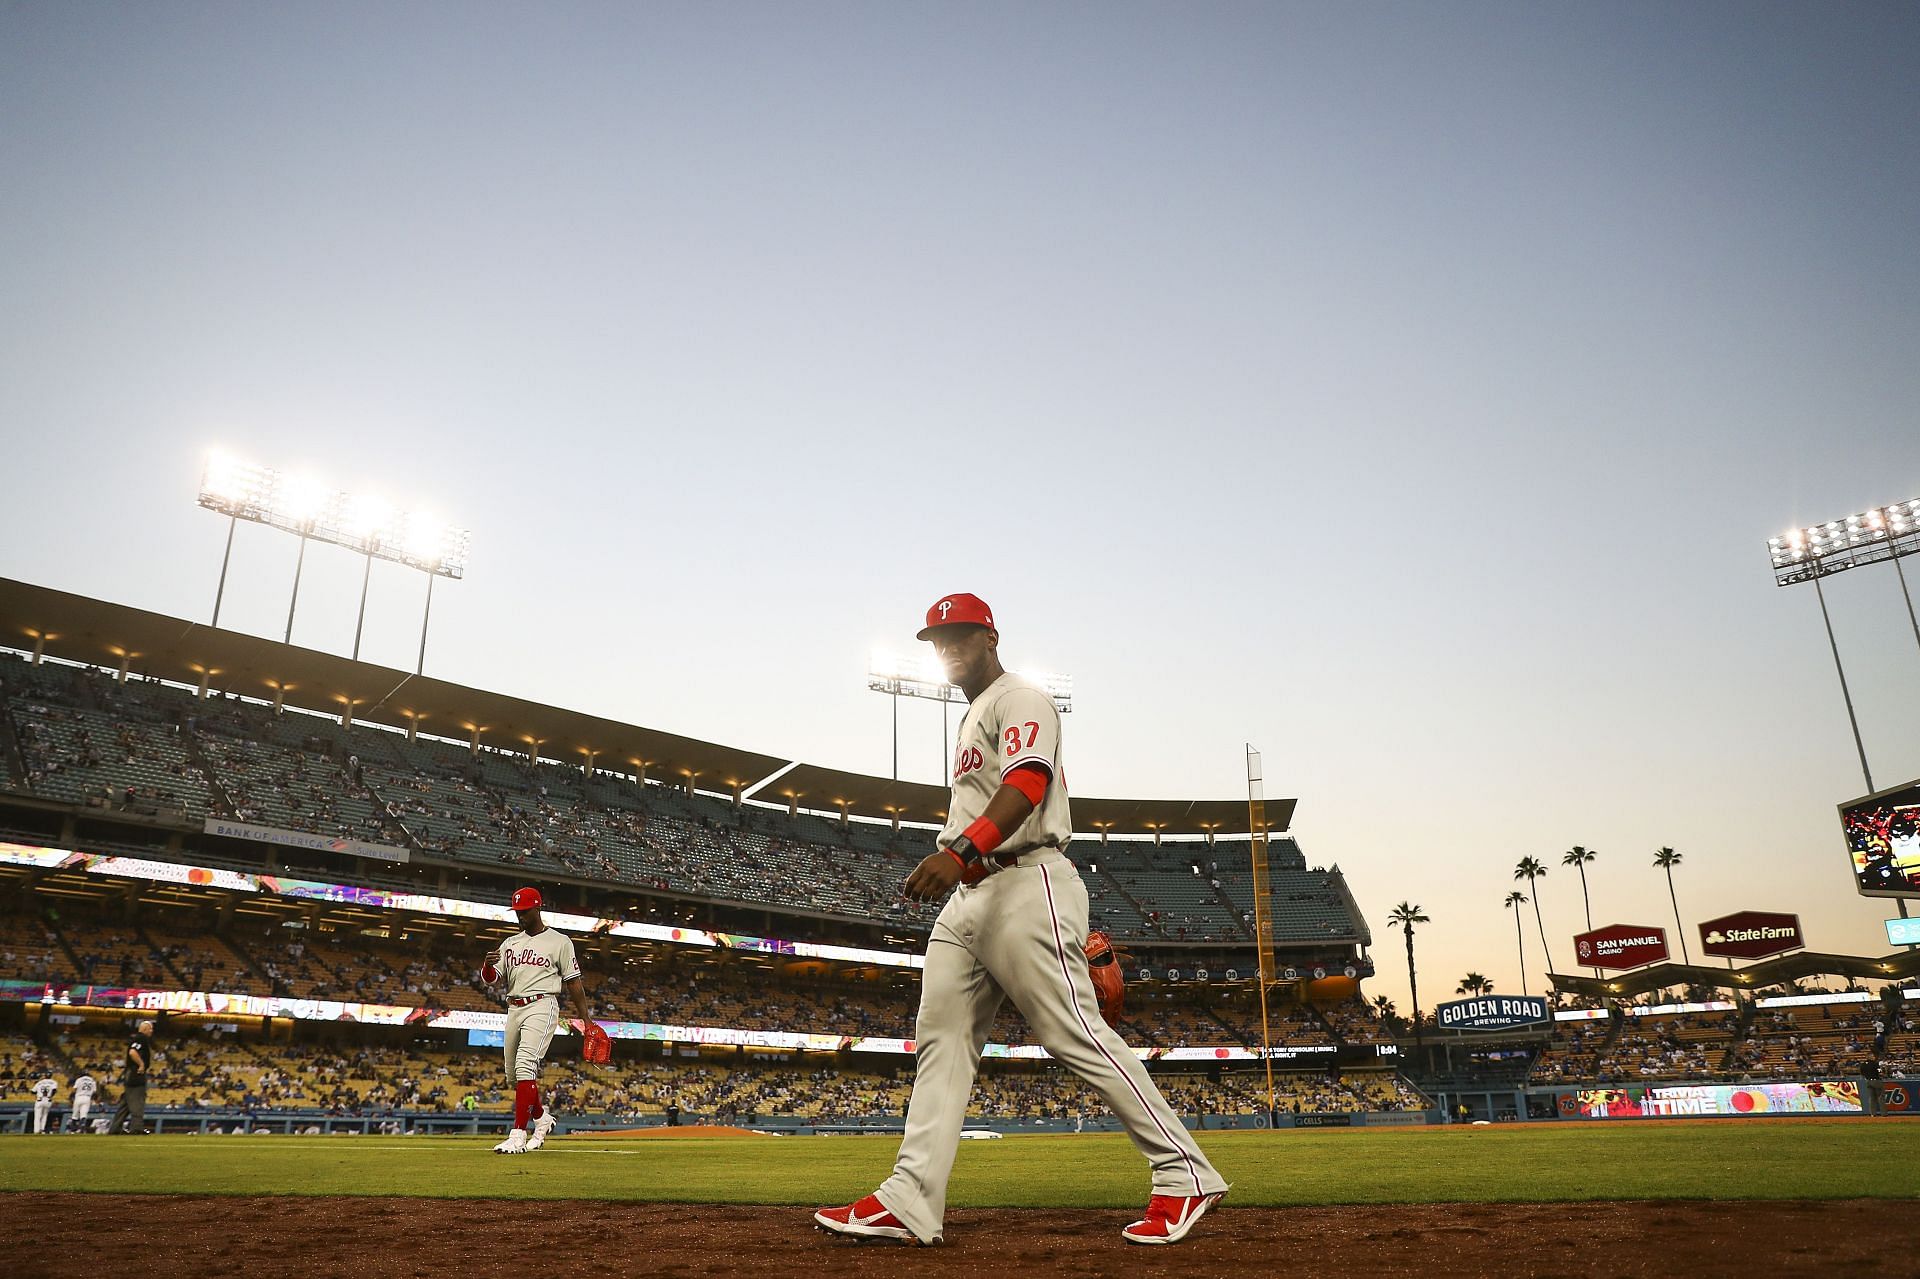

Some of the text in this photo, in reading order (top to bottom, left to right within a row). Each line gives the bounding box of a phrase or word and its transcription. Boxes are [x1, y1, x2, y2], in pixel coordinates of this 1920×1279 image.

[938, 600, 952, 620] P
[1003, 720, 1040, 757] 37
[217, 825, 400, 860] BANK OF AMERICA Suite Level
[514, 894, 521, 903] P
[1596, 936, 1662, 949] SAN MANUEL
[505, 948, 551, 968] Phillies
[1141, 971, 1150, 979] 20
[1169, 971, 1179, 979] 24
[1198, 971, 1207, 979] 32
[137, 991, 279, 1016] TRIVIA TIME
[1442, 999, 1542, 1024] GOLDEN ROAD
[1474, 1017, 1512, 1026] BREWING
[663, 1026, 720, 1043] TRIVIA
[1652, 1086, 1704, 1099] TRIVIA
[1883, 1087, 1906, 1105] 76
[1653, 1098, 1717, 1115] TIME
